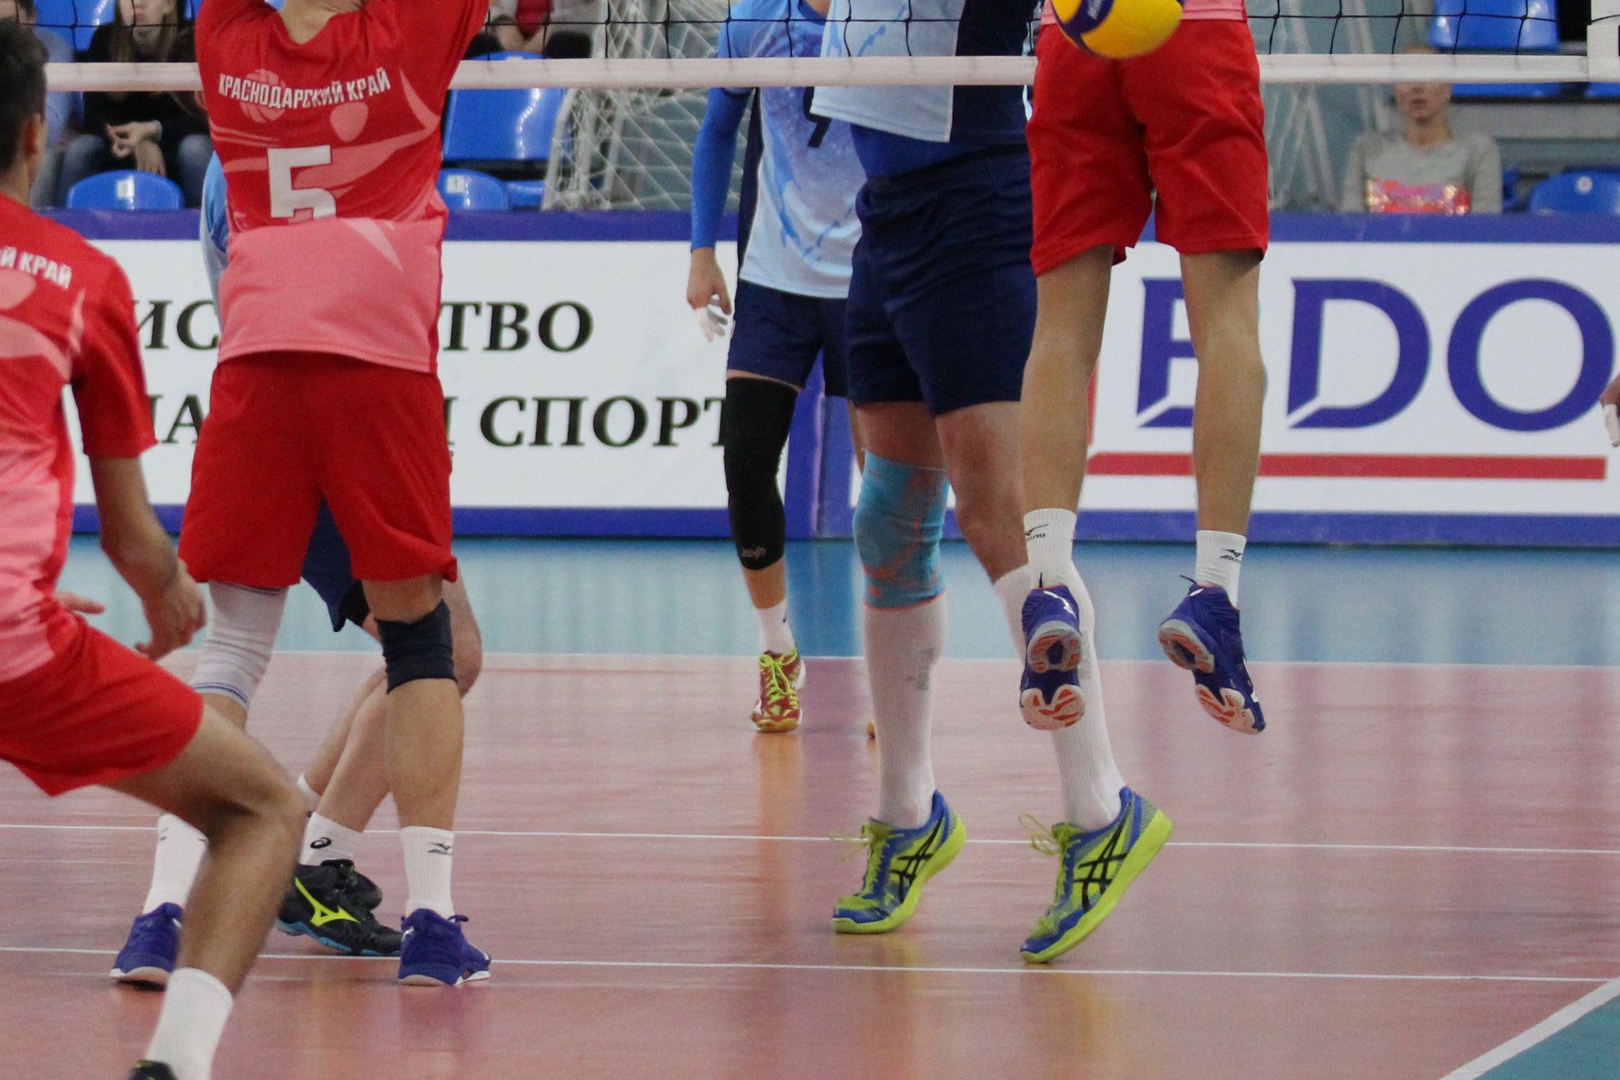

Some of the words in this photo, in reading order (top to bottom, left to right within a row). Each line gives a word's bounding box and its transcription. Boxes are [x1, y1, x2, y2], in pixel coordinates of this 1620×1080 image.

[218, 73, 345, 110] КРАСНОДАРСКИЙ
[346, 66, 392, 102] КРАЙ
[267, 144, 337, 221] 5
[19, 251, 73, 290] КРАЙ
